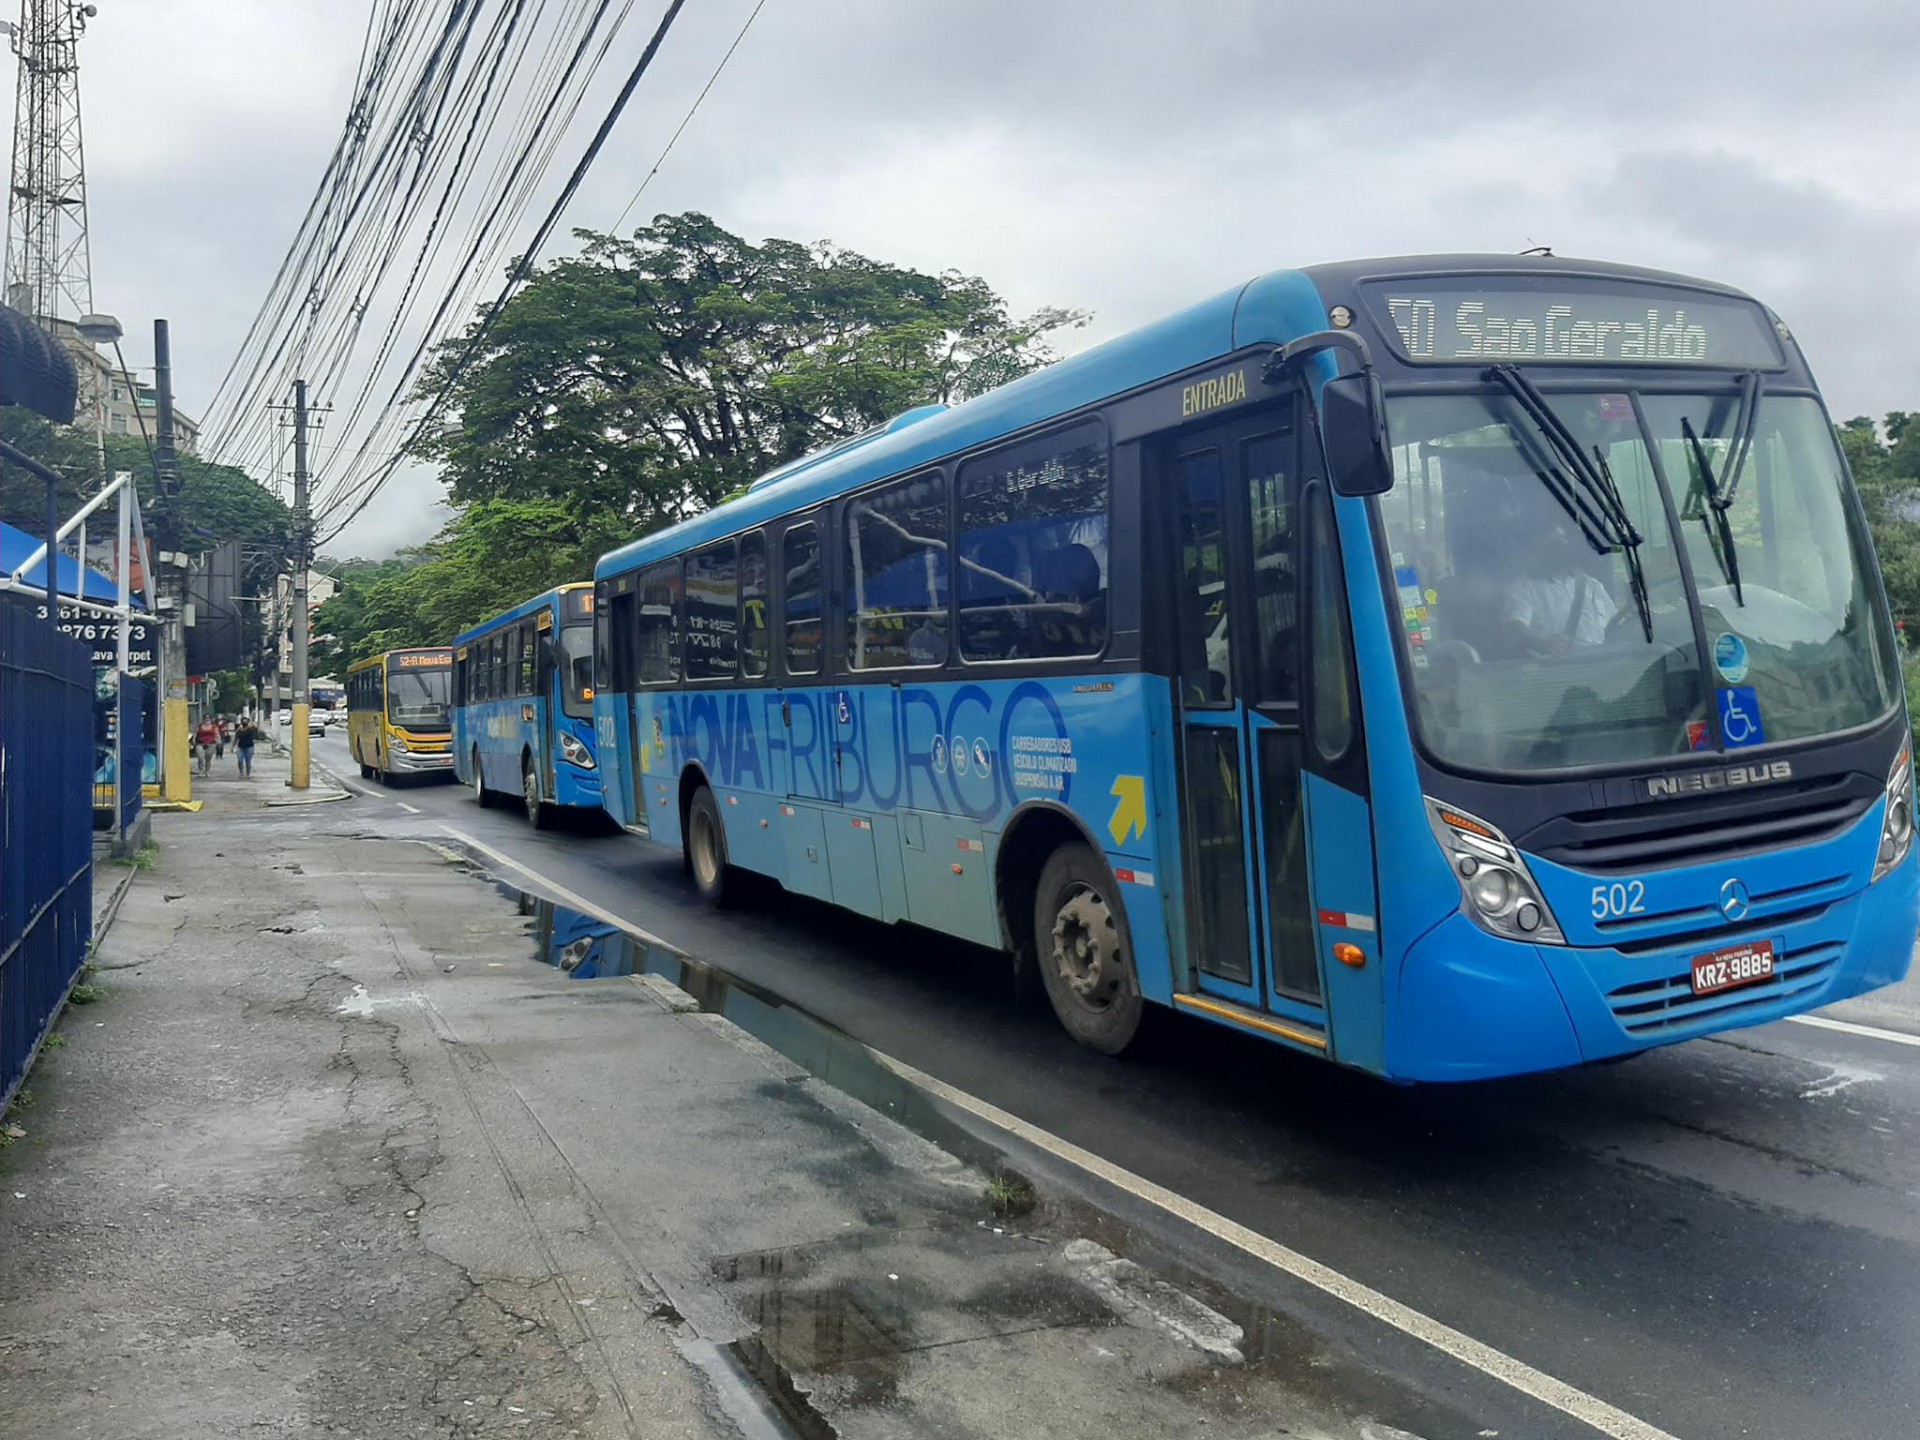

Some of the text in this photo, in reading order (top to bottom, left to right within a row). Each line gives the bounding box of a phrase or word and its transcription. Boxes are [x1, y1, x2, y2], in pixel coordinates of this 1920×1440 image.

[1182, 369, 1246, 417] ENTRADA
[667, 681, 1072, 826] NOVA FRIBURGO
[1012, 736, 1072, 754] CARREGADORES USB
[1038, 755, 1077, 774] CLIMATIZADO
[1647, 760, 1793, 797] NEOBUS
[1590, 880, 1646, 919] 502
